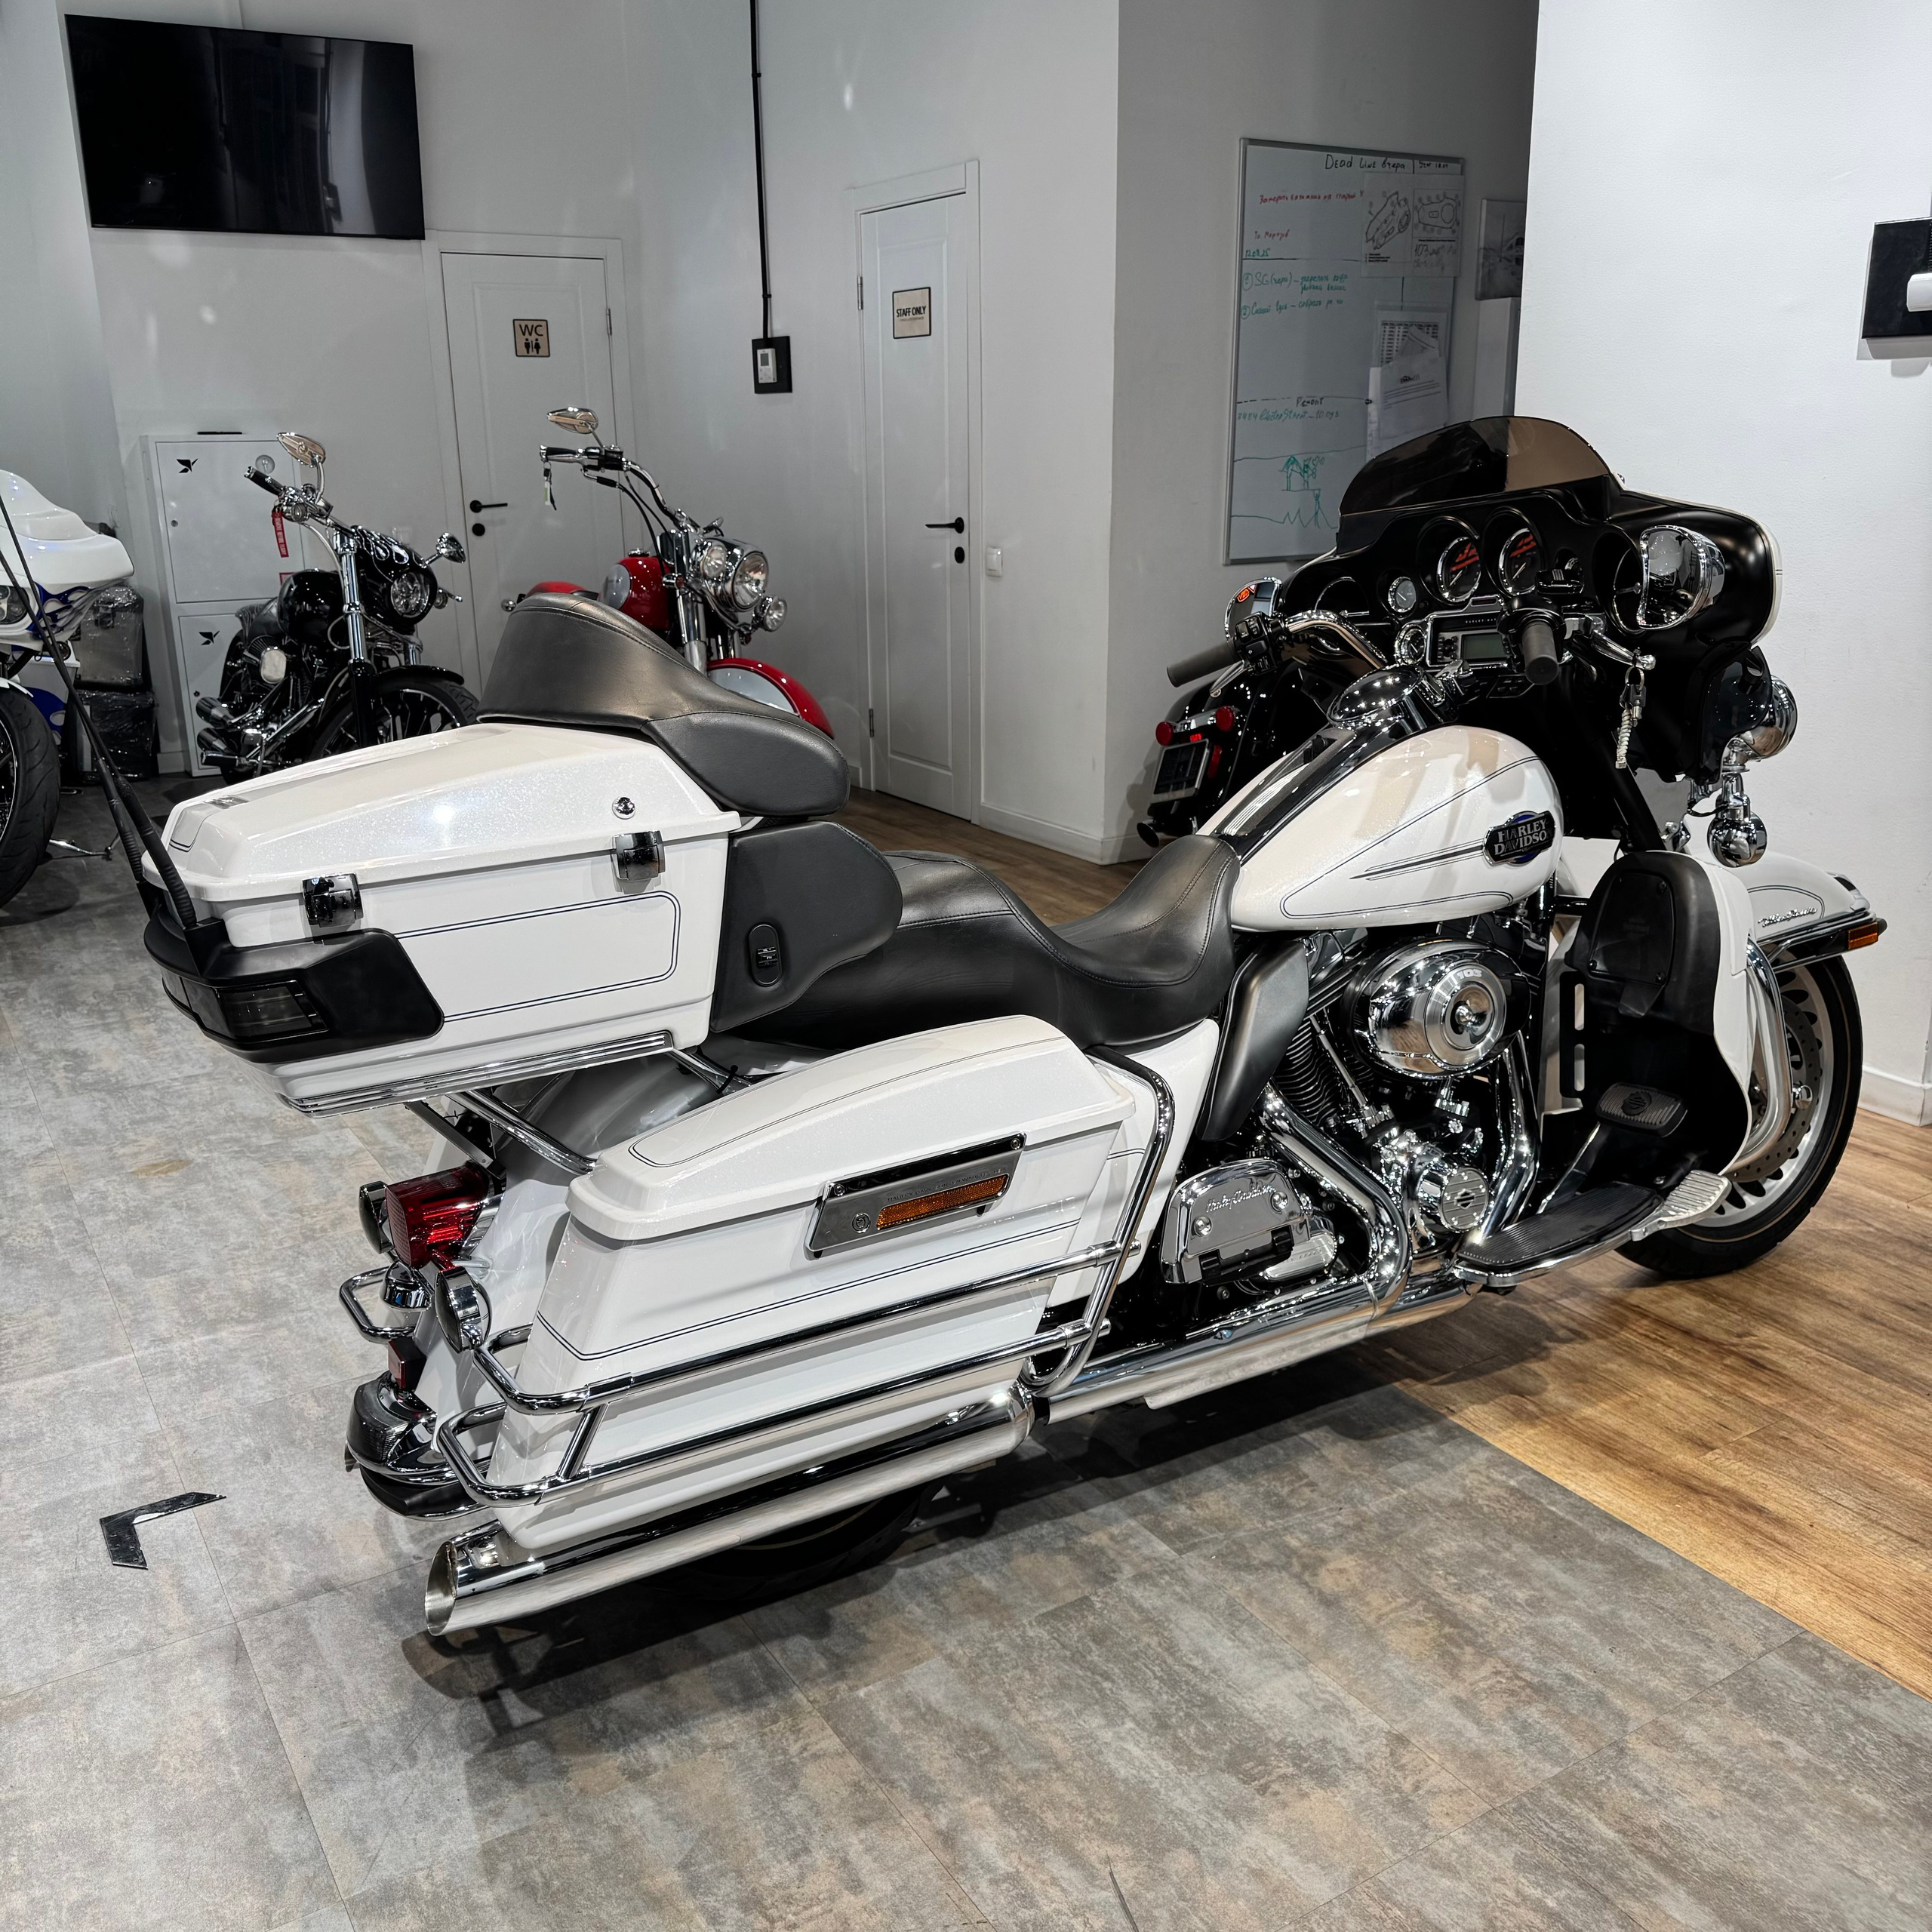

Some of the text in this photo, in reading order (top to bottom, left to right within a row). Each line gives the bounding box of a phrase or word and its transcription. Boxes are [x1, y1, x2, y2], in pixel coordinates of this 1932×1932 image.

[896, 306, 927, 318] STAFF ONLY
[518, 324, 543, 337] WC
